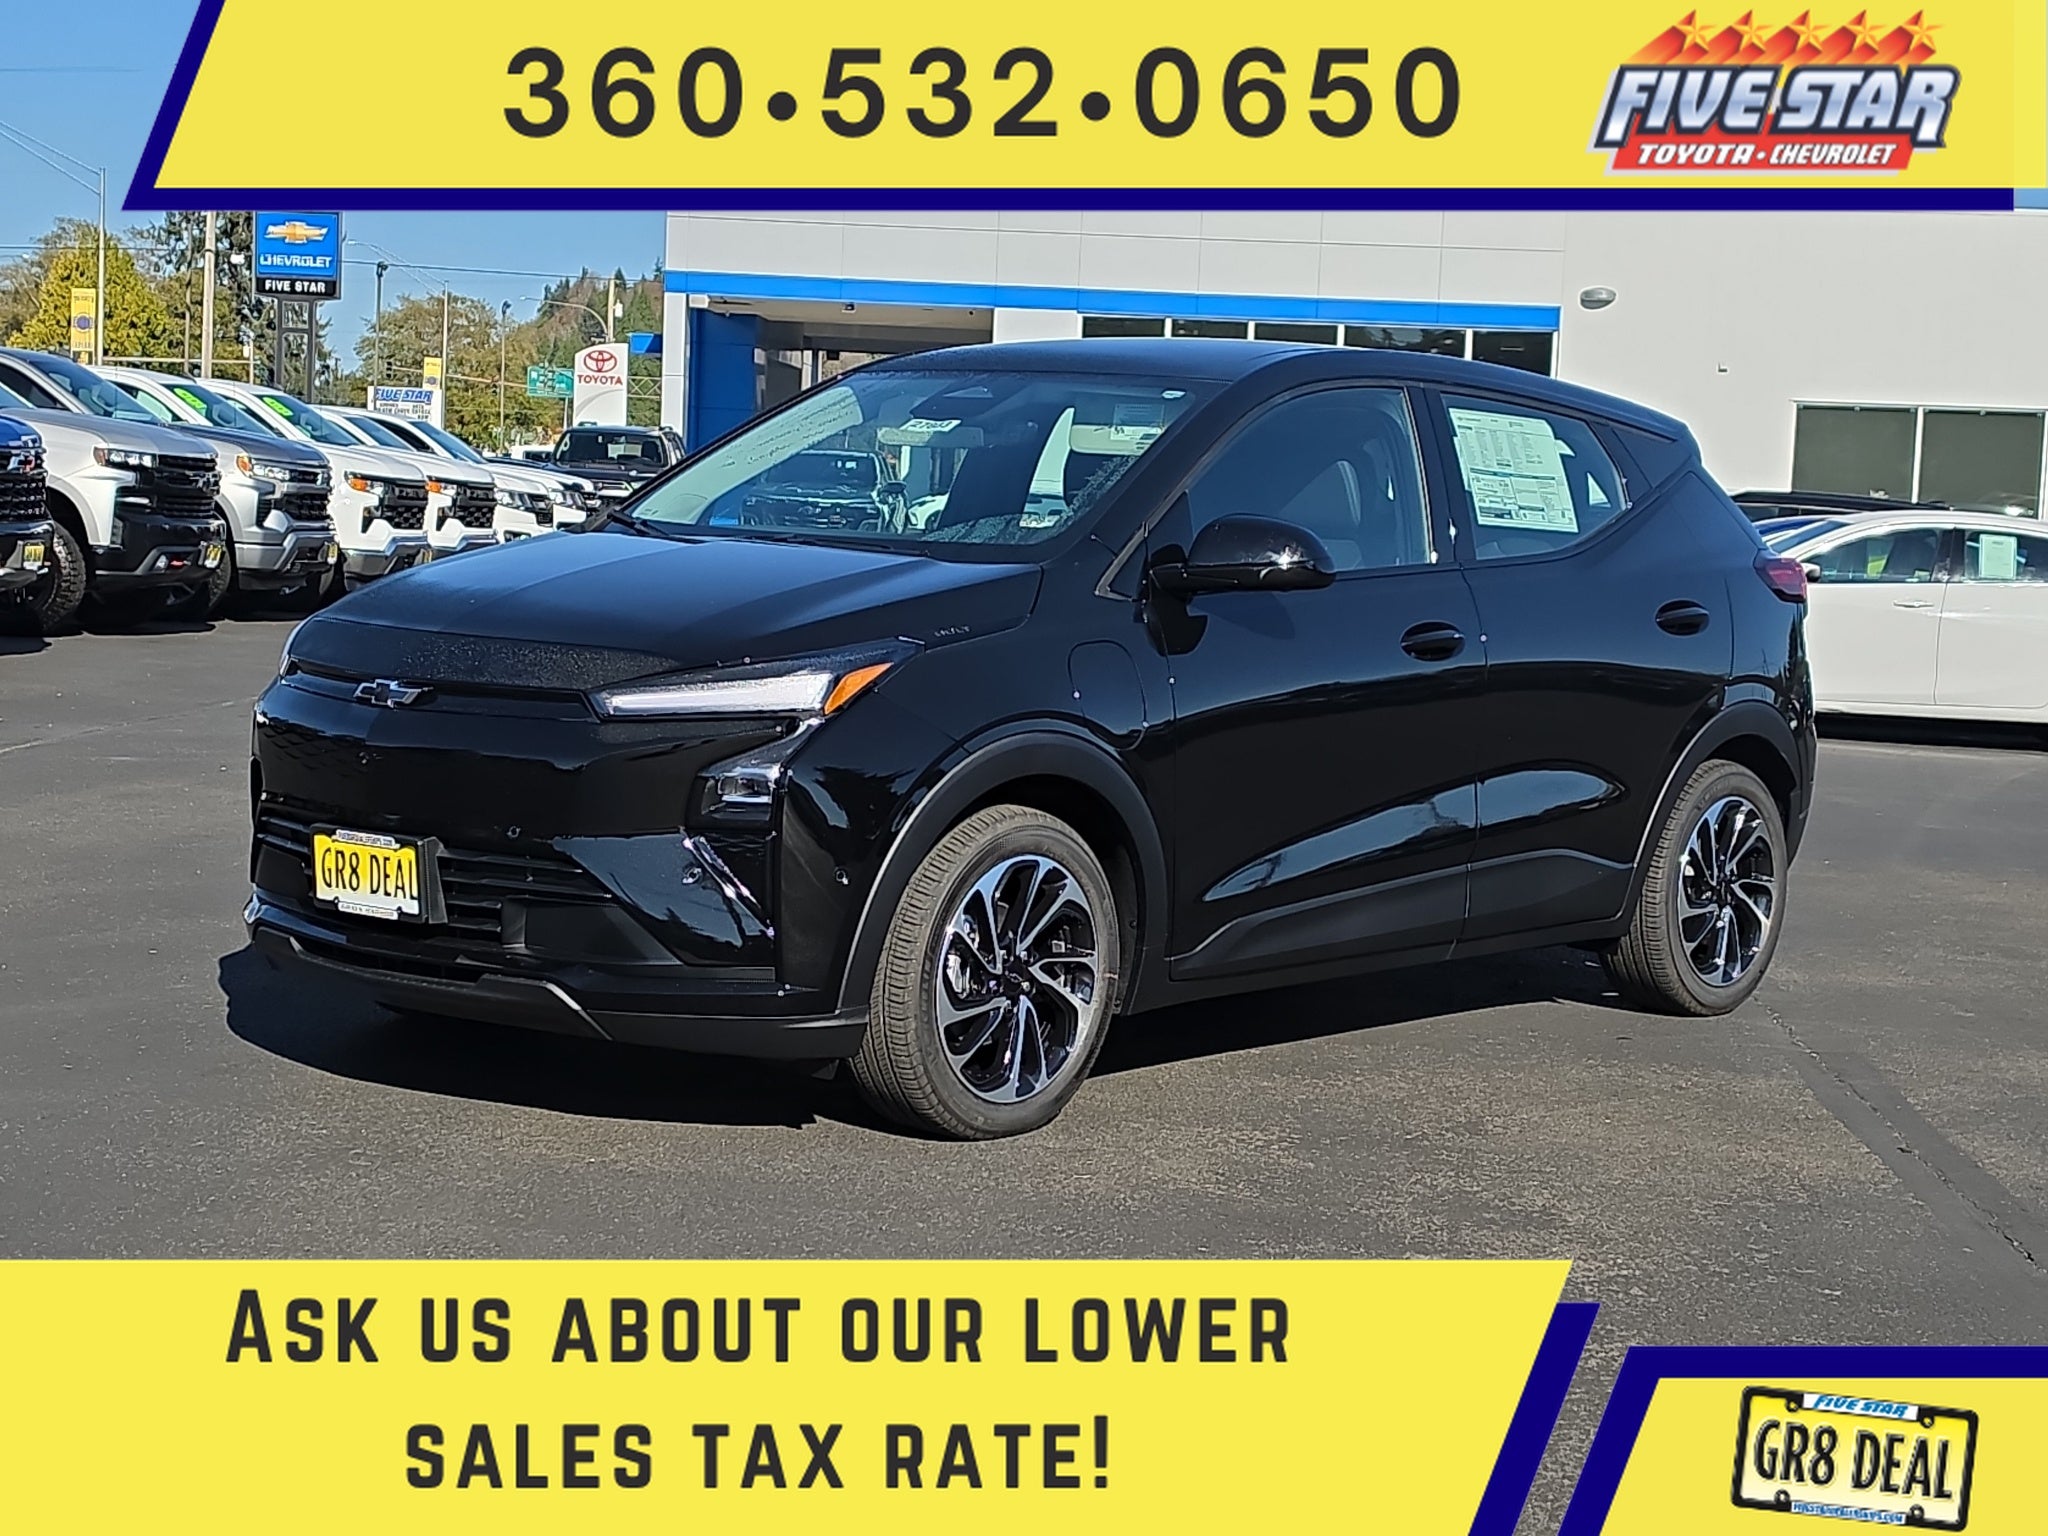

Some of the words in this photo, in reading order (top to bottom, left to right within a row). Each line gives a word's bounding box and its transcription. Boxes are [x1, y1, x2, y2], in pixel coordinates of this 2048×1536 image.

[259, 253, 333, 268] CHEVROLET
[264, 279, 291, 292] FIVE
[295, 280, 326, 294] STAR
[577, 374, 623, 386] TOYOTA
[402, 389, 433, 404] STAR
[321, 847, 361, 892] GR8
[369, 854, 419, 900] DEAL
